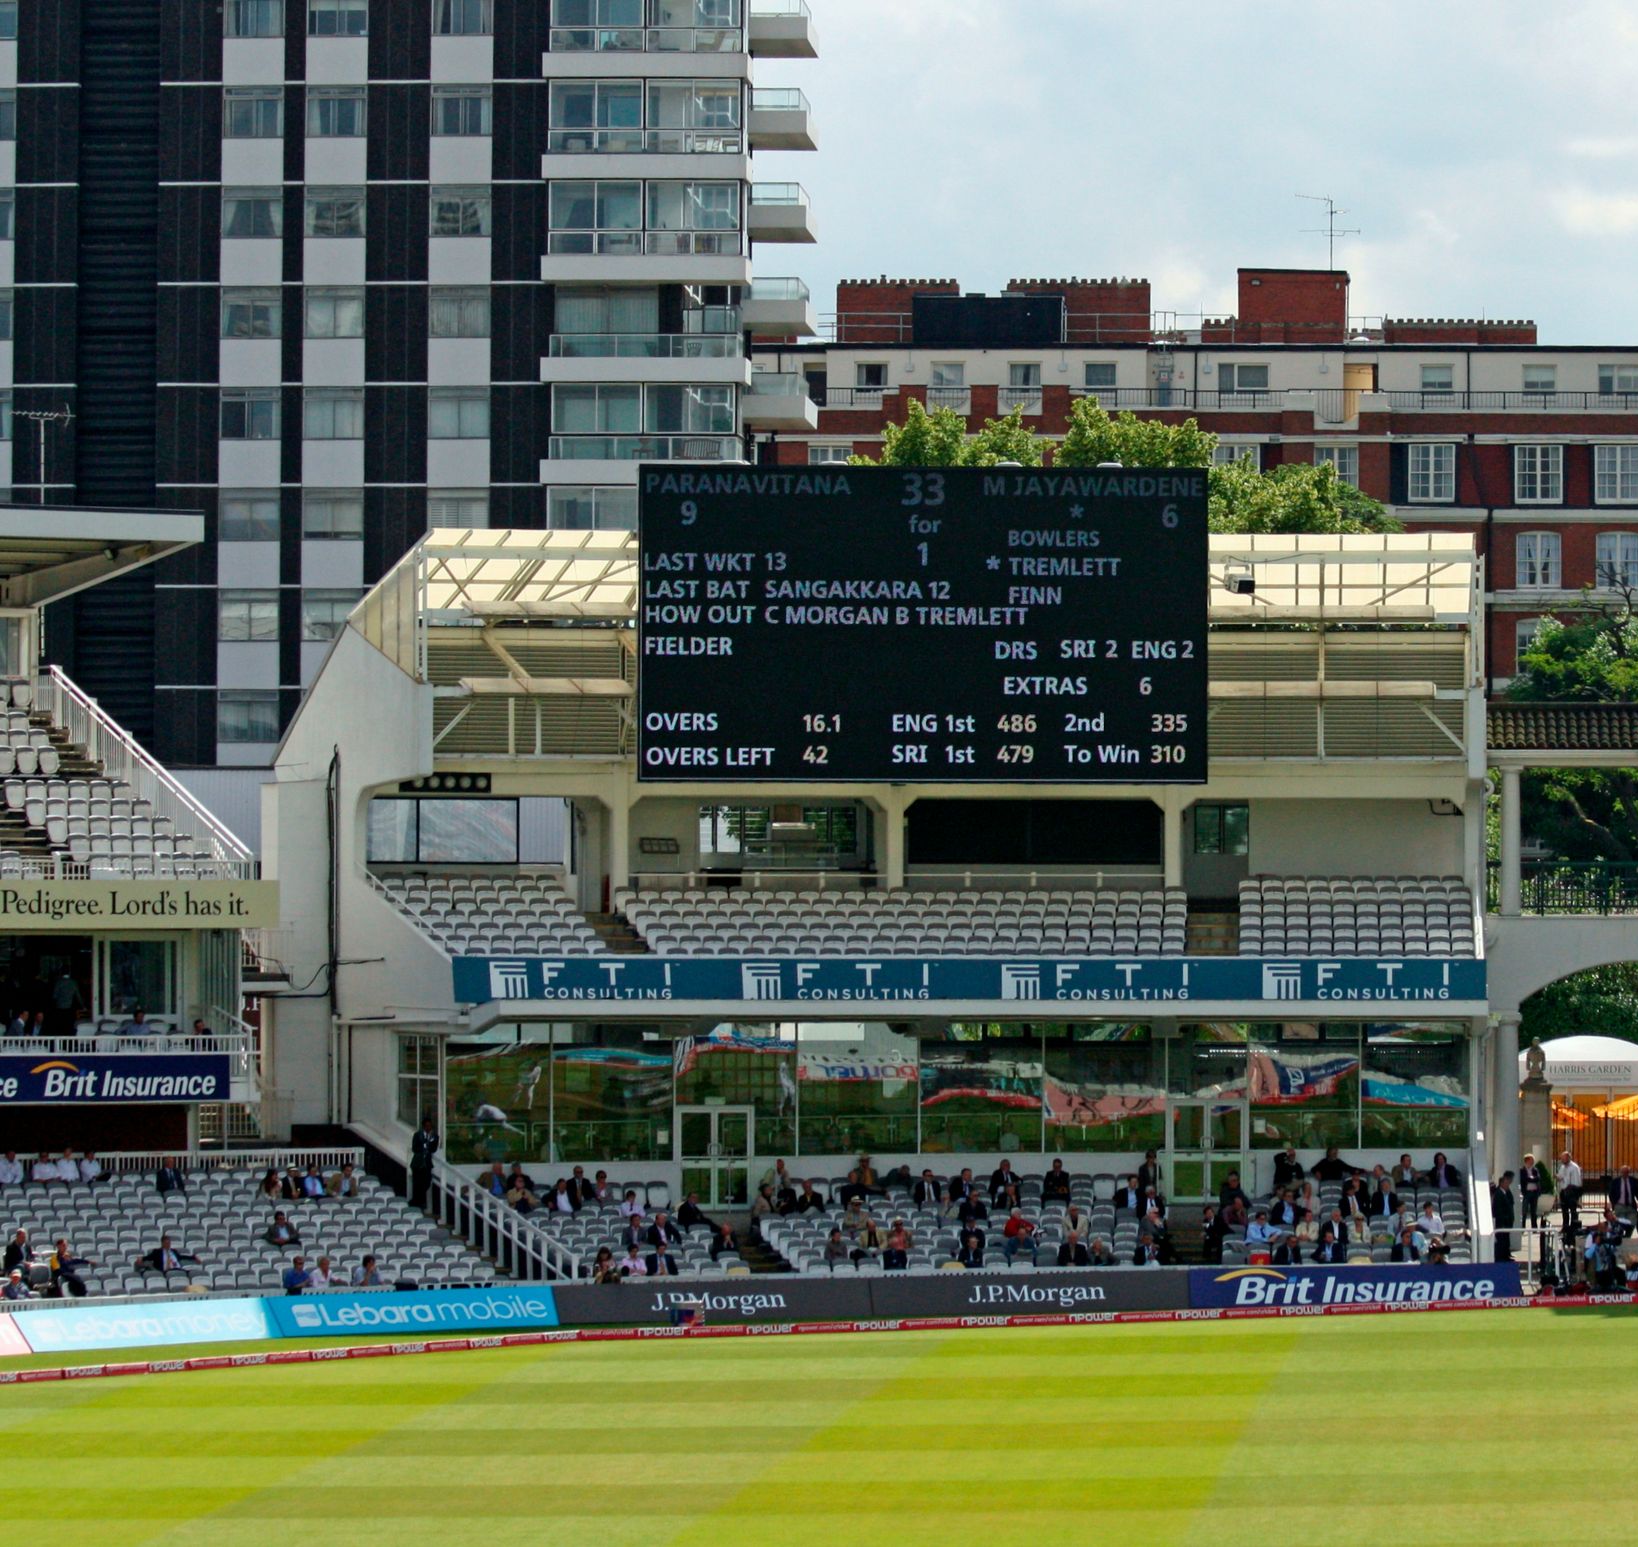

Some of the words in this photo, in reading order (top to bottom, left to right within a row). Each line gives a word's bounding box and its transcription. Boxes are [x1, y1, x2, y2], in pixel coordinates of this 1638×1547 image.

[647, 474, 852, 495] PARANAVITANA
[901, 473, 945, 506] 33
[984, 476, 1005, 495] M
[1014, 476, 1202, 496] JAYAWARDENE
[681, 501, 697, 525] 9
[1162, 504, 1178, 528] 6
[909, 514, 941, 533] for
[1008, 530, 1100, 547] BOWLERS
[645, 553, 698, 571] LAST
[704, 553, 755, 571] WKT
[765, 552, 786, 570] 13
[917, 542, 928, 566] 1
[1009, 557, 1121, 576] TREMLETT
[646, 580, 699, 598] LAST
[707, 580, 750, 598] BAT
[765, 580, 923, 599] SANGAKKARA
[928, 581, 950, 599] 12
[1009, 586, 1061, 604] FINN
[646, 605, 701, 623] HOW
[708, 606, 756, 623] OUT
[765, 606, 779, 624] C
[786, 606, 888, 624] MORGAN
[896, 607, 909, 625] B
[916, 607, 1028, 625] TREMLETT
[646, 637, 732, 655] FIELDER
[995, 641, 1037, 660] DRS
[1061, 640, 1096, 658] SRI
[1106, 640, 1118, 658] 2
[1132, 640, 1176, 659] ENG
[1181, 640, 1194, 658] 2
[1004, 677, 1087, 695] EXTRAS
[1140, 677, 1152, 695] 6
[646, 713, 718, 731] OVERS
[803, 714, 840, 732] 16.1
[893, 714, 937, 732] ENG
[945, 714, 975, 732] 1st
[997, 714, 1037, 732] 486
[1065, 712, 1104, 732] 2nd
[1151, 714, 1187, 732] 335
[646, 747, 719, 766] OVERS
[726, 748, 775, 766] LEFT
[803, 746, 828, 764] 42
[892, 745, 928, 763] SRI
[945, 745, 975, 763] 1st
[997, 745, 1034, 763] 479
[1064, 745, 1091, 763] To
[1098, 744, 1139, 763] Win
[1151, 745, 1185, 763] 310
[1, 890, 103, 920] Pedigree.
[110, 891, 177, 915] Lord's
[185, 891, 221, 915] has
[229, 893, 248, 915] it.
[544, 988, 672, 1000] CONSULTING
[796, 988, 930, 1001] CONSULTING
[1056, 988, 1189, 1001] CONSULTING
[1317, 989, 1450, 1000] CONSULTING
[1550, 1065, 1586, 1074] HARRIS
[1588, 1065, 1631, 1076] GARDEN
[44, 1070, 98, 1096] Brit
[102, 1070, 216, 1096] Insurance
[969, 1285, 1106, 1307] J.P.Morgan
[1235, 1276, 1314, 1304] Brit
[1322, 1276, 1494, 1303] Insurance
[325, 1302, 434, 1325] Lebara
[436, 1295, 547, 1320] mobile
[1280, 1305, 1327, 1315] npower
